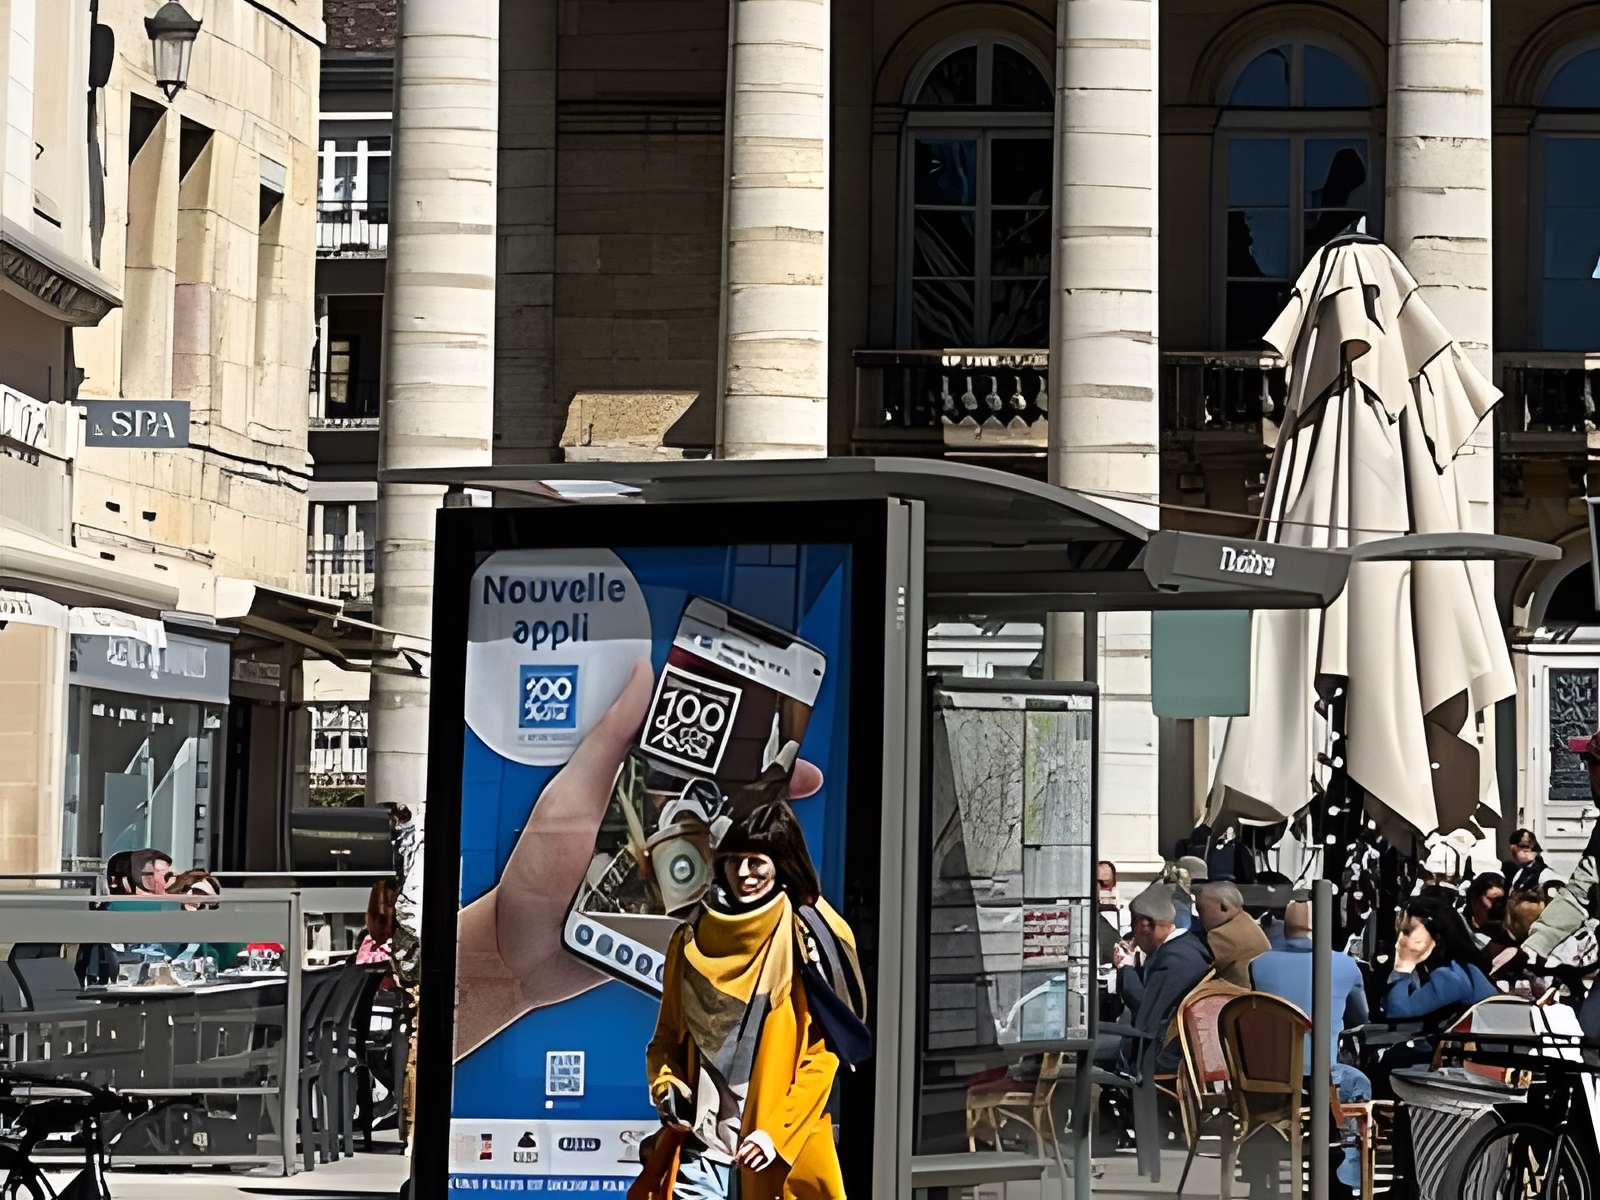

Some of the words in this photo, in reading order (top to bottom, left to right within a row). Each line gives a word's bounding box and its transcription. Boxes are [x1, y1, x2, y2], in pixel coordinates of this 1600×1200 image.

[111, 409, 175, 439] SPA
[483, 572, 626, 605] Nouvelle
[512, 612, 589, 651] appli
